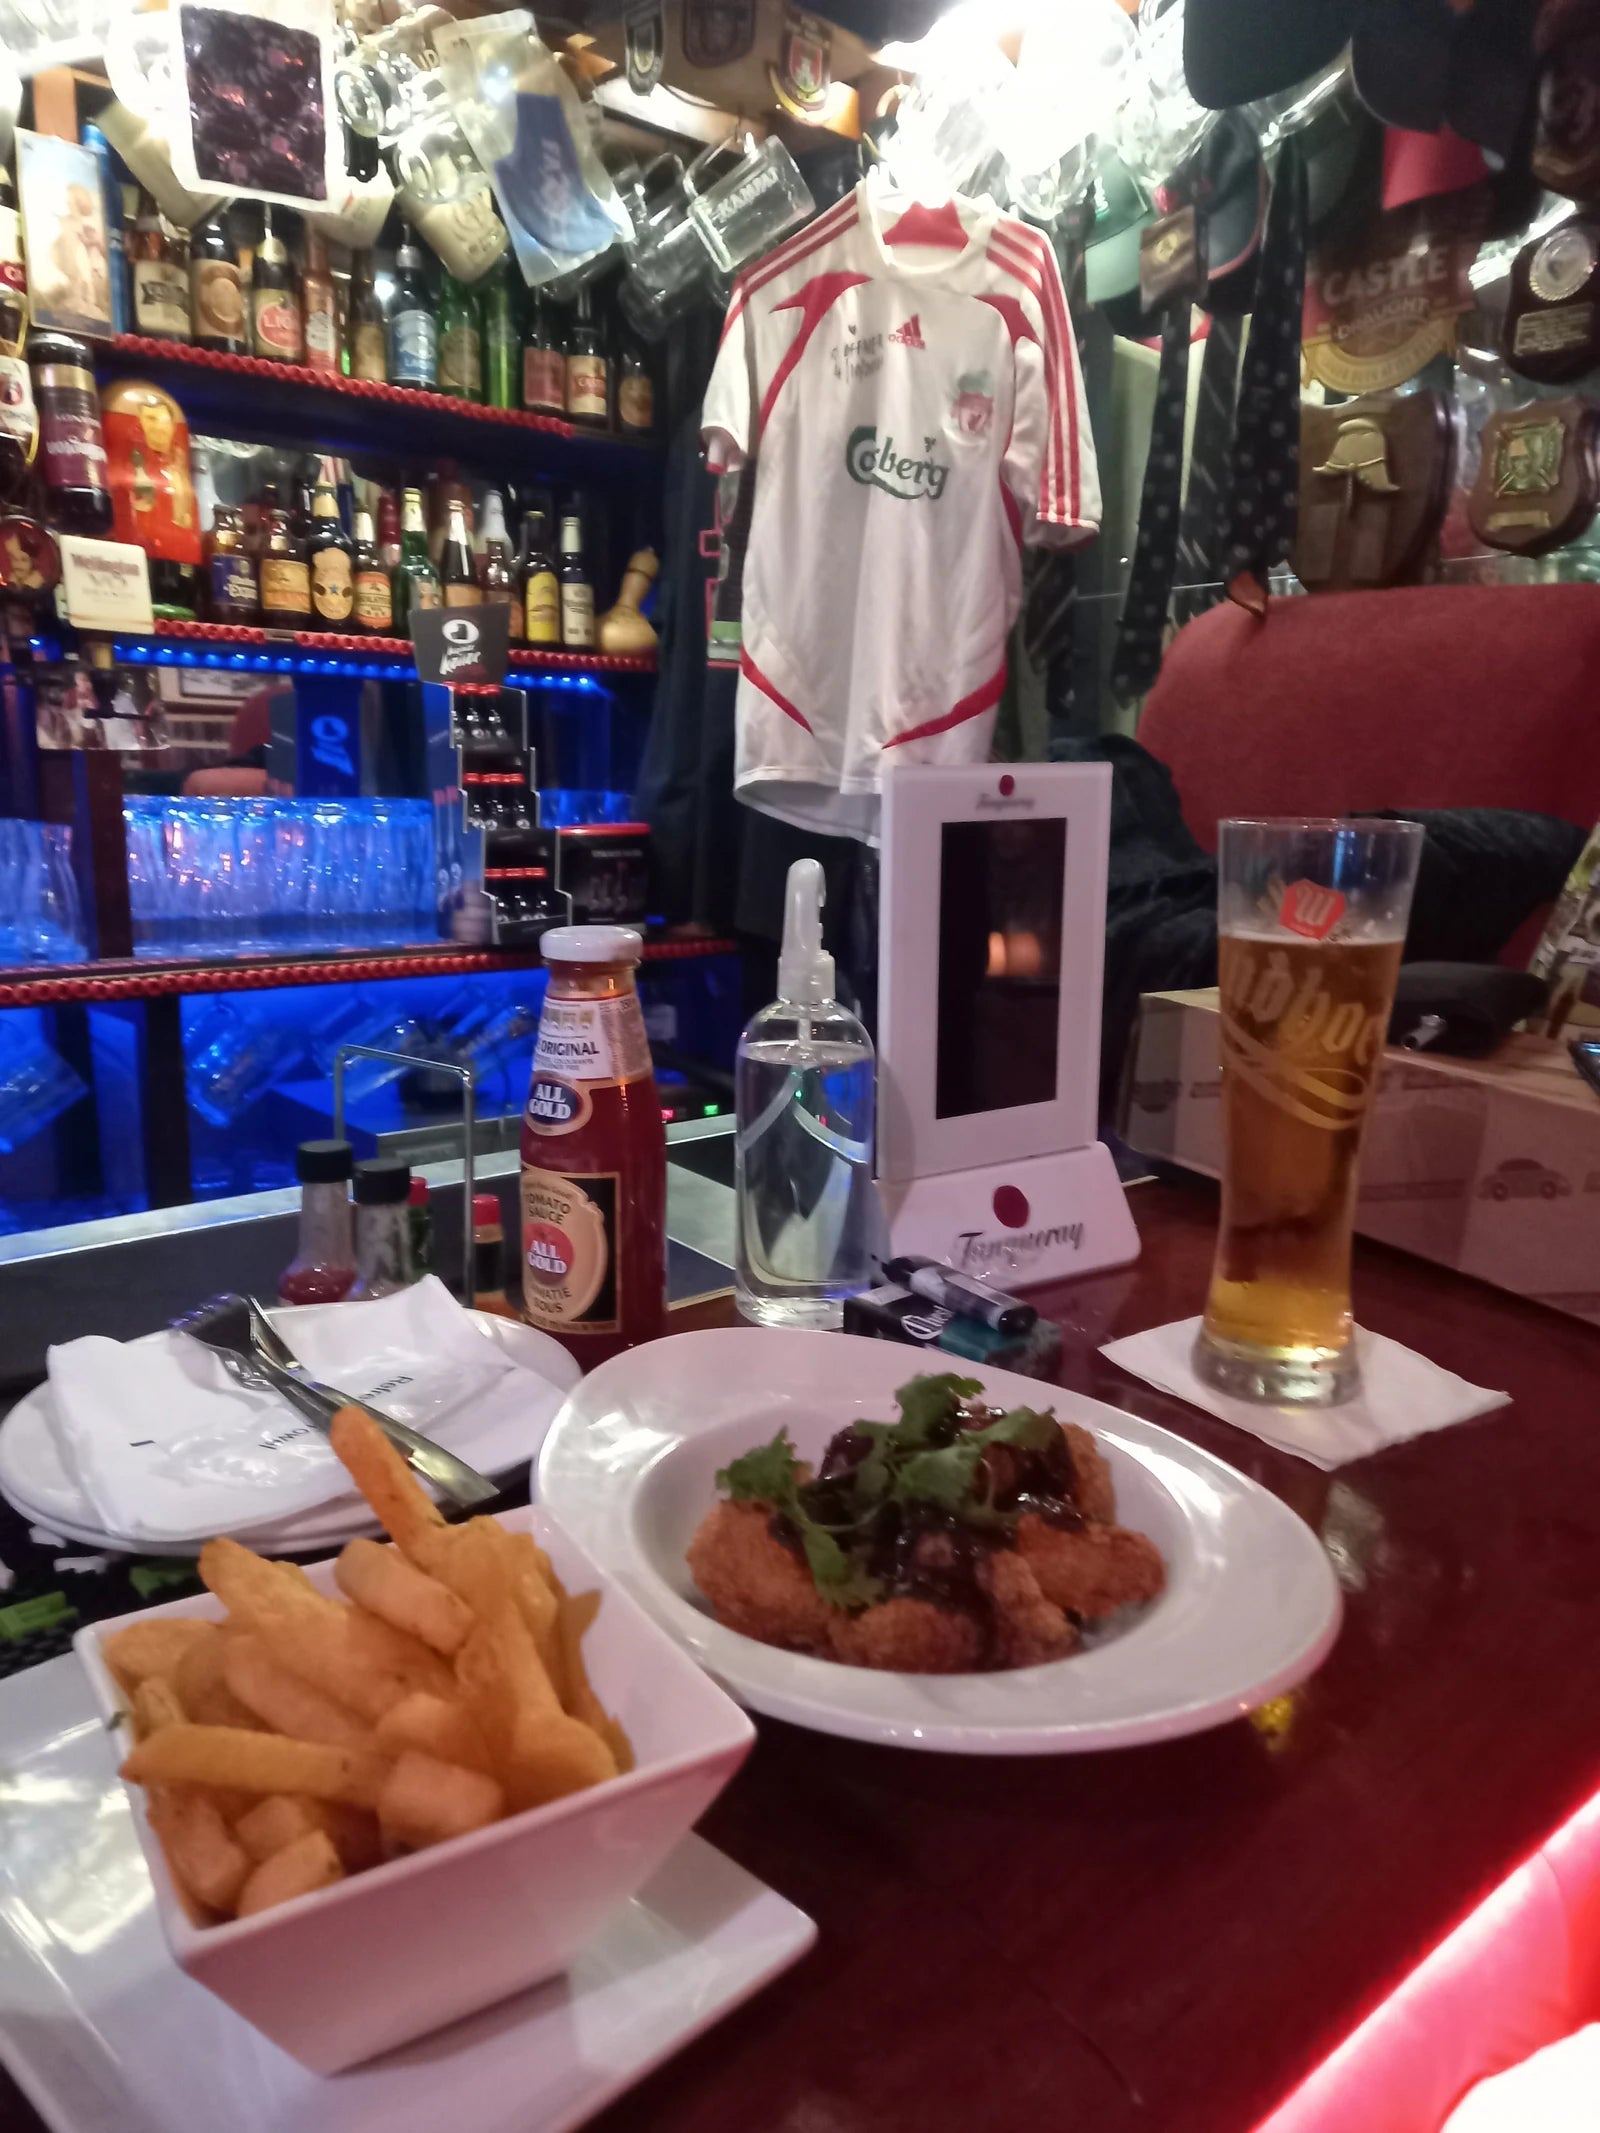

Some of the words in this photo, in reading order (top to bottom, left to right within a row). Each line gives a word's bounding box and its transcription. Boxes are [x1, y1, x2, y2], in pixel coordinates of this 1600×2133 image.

[1323, 251, 1448, 304] CASTLE
[541, 1040, 600, 1057] ORIGINAL
[535, 1083, 566, 1103] ALL
[529, 1099, 571, 1120] GOLD
[528, 1207, 564, 1225] SAUCE
[531, 1240, 561, 1260] ALL
[527, 1252, 567, 1274] GOLD
